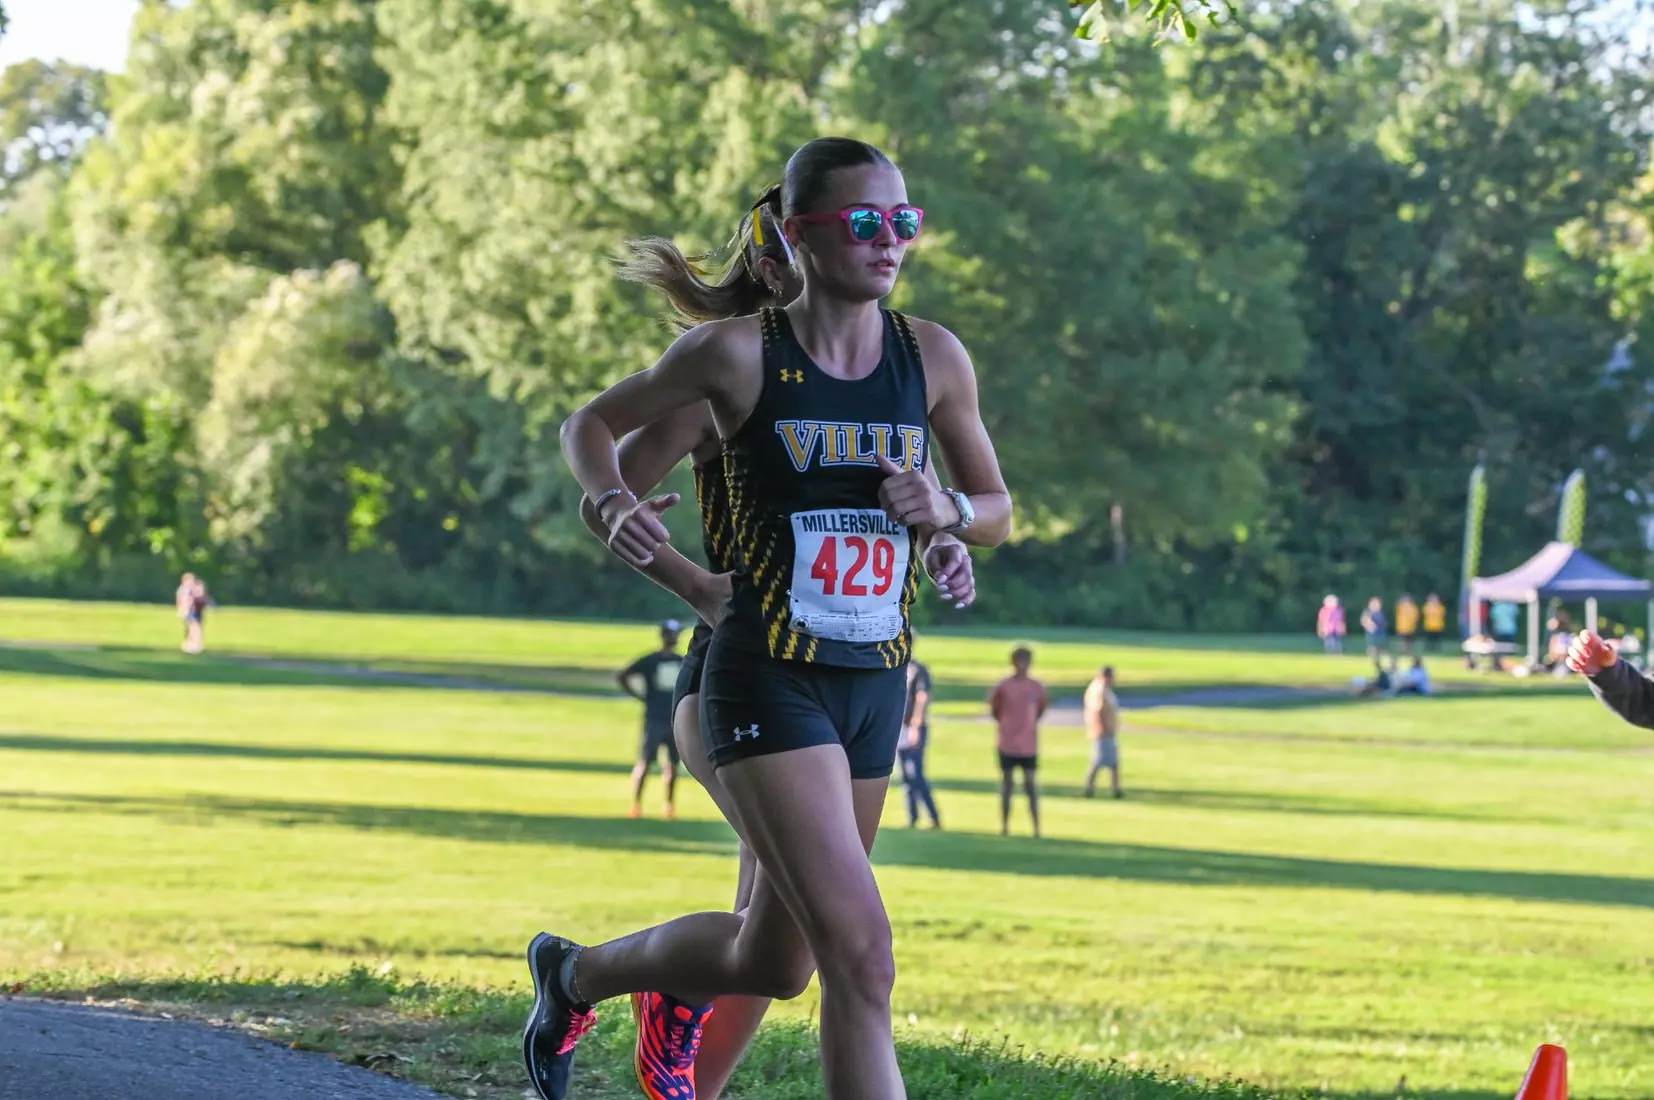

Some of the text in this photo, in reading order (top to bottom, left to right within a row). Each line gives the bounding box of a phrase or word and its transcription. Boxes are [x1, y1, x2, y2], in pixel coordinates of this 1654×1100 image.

[775, 420, 924, 472] VILLE
[801, 514, 900, 535] MILLERSVILLE
[811, 536, 895, 596] 429
